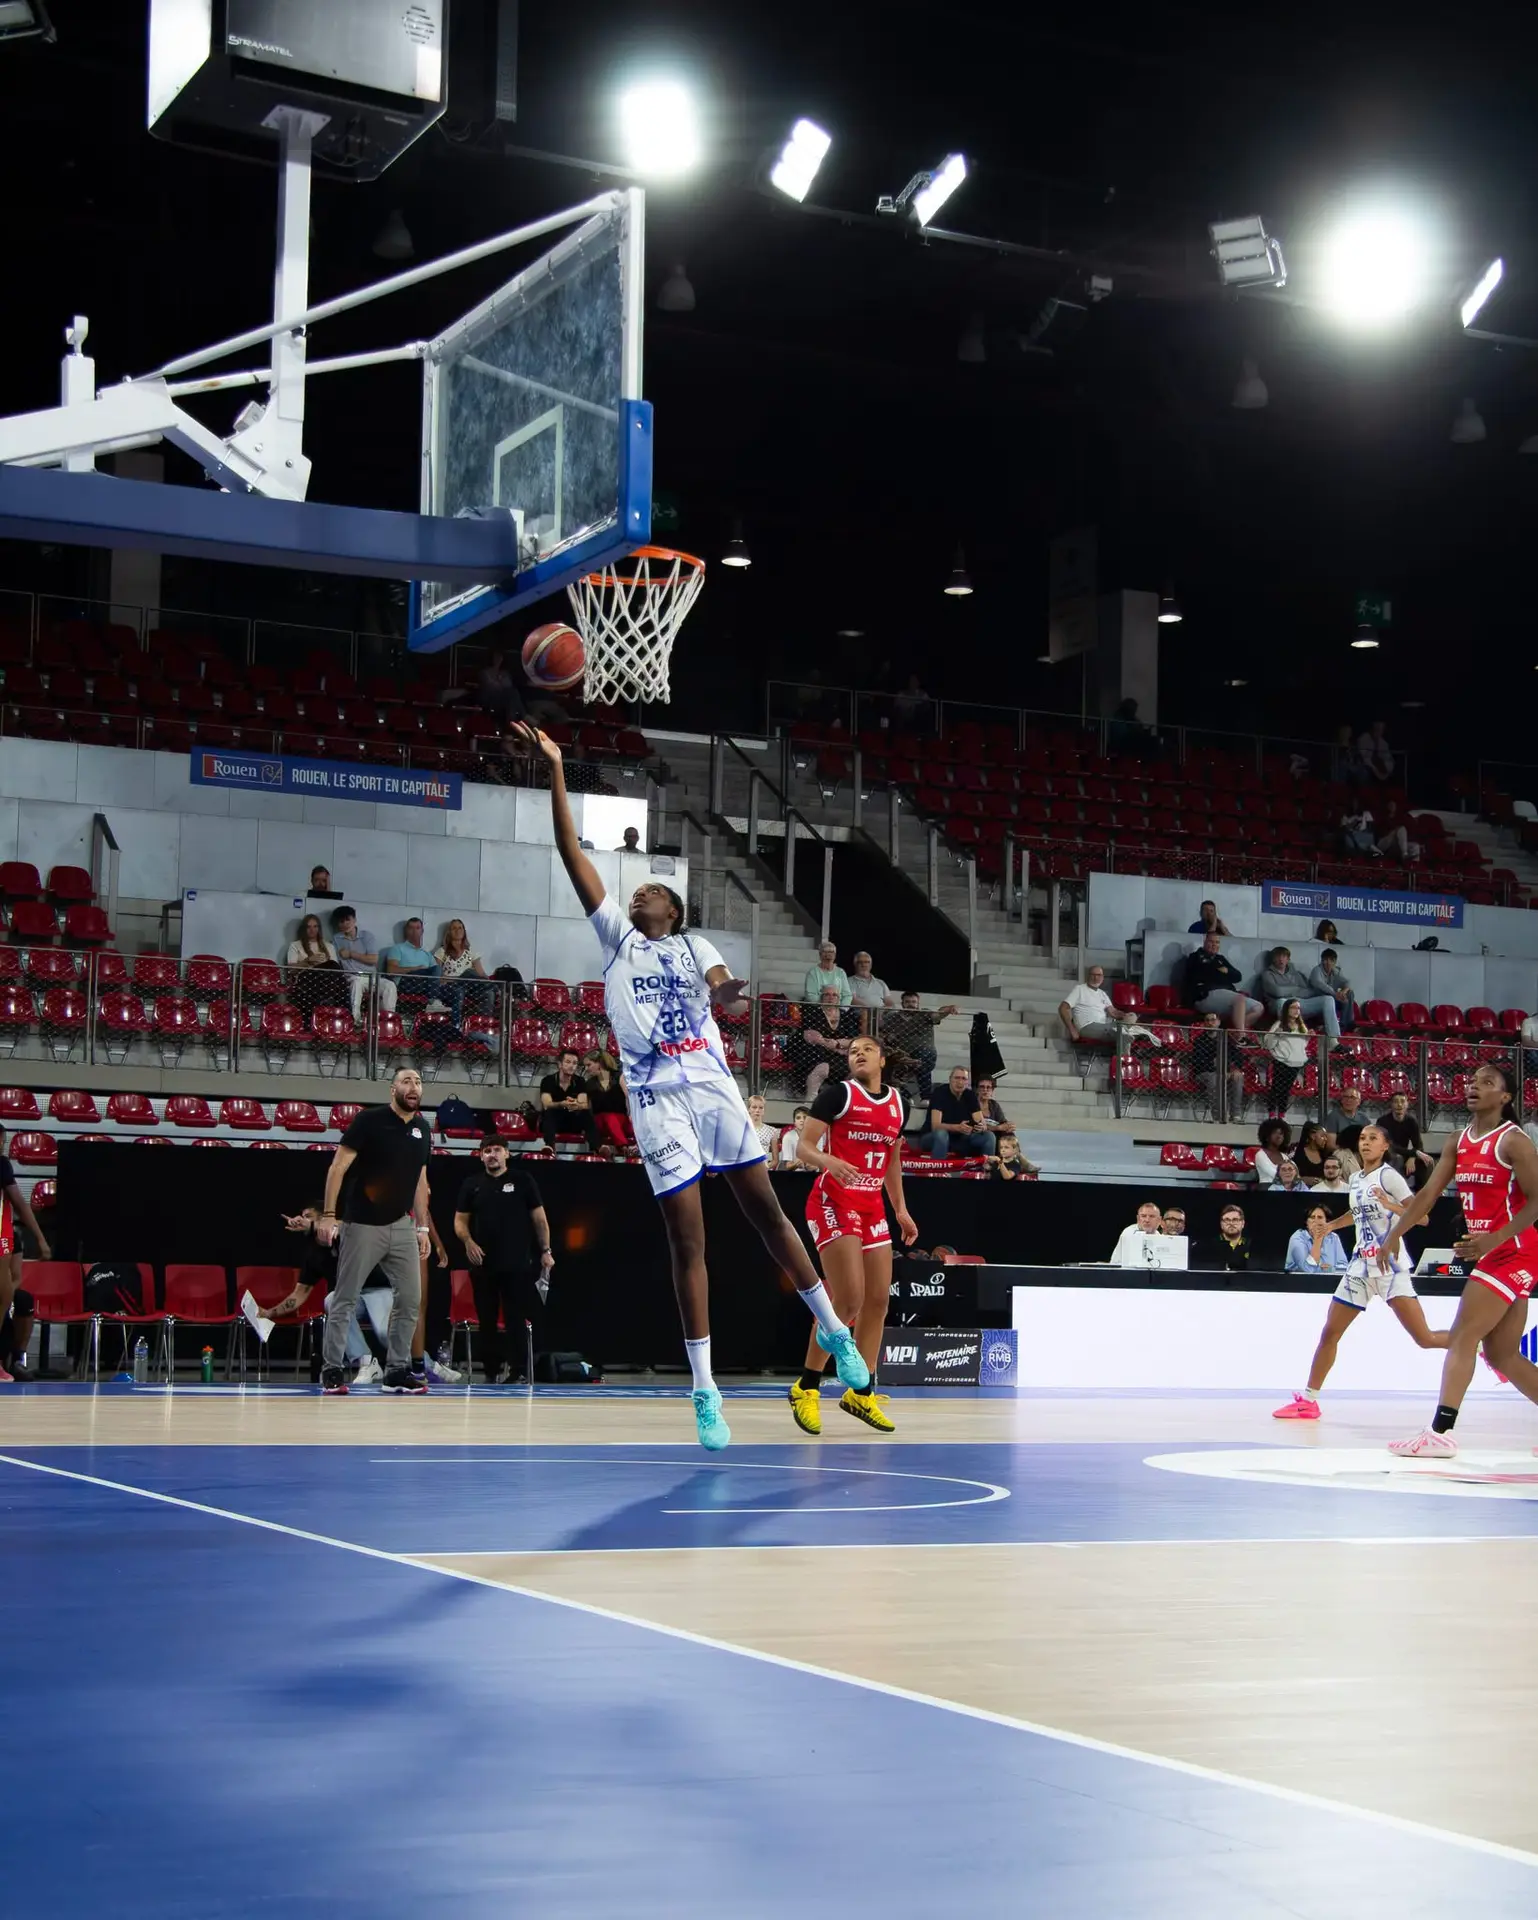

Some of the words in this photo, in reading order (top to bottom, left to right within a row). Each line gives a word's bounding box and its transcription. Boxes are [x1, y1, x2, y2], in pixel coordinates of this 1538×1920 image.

[228, 34, 293, 57] STRAMATEL
[213, 760, 257, 778] Rouen
[292, 768, 331, 787] ROUEN,
[333, 772, 347, 788] LE
[349, 774, 383, 791] SPORT
[385, 778, 399, 793] EN
[401, 780, 451, 798] CAPITALE
[1278, 891, 1312, 906] Rouen
[1336, 896, 1366, 912] ROUEN,
[1368, 899, 1378, 913] LE
[1379, 900, 1404, 915] SPORT
[1406, 902, 1417, 915] EN
[1418, 903, 1455, 919] CAPITALE
[660, 1009, 687, 1035] 23
[638, 1088, 656, 1109] 23
[865, 1151, 886, 1169] 17
[1460, 1192, 1474, 1211] 21
[884, 1346, 918, 1363] MPI
[925, 1344, 978, 1362] PARTENAIRE
[989, 1353, 1012, 1362] RMB
[935, 1356, 970, 1369] MAJEUR
